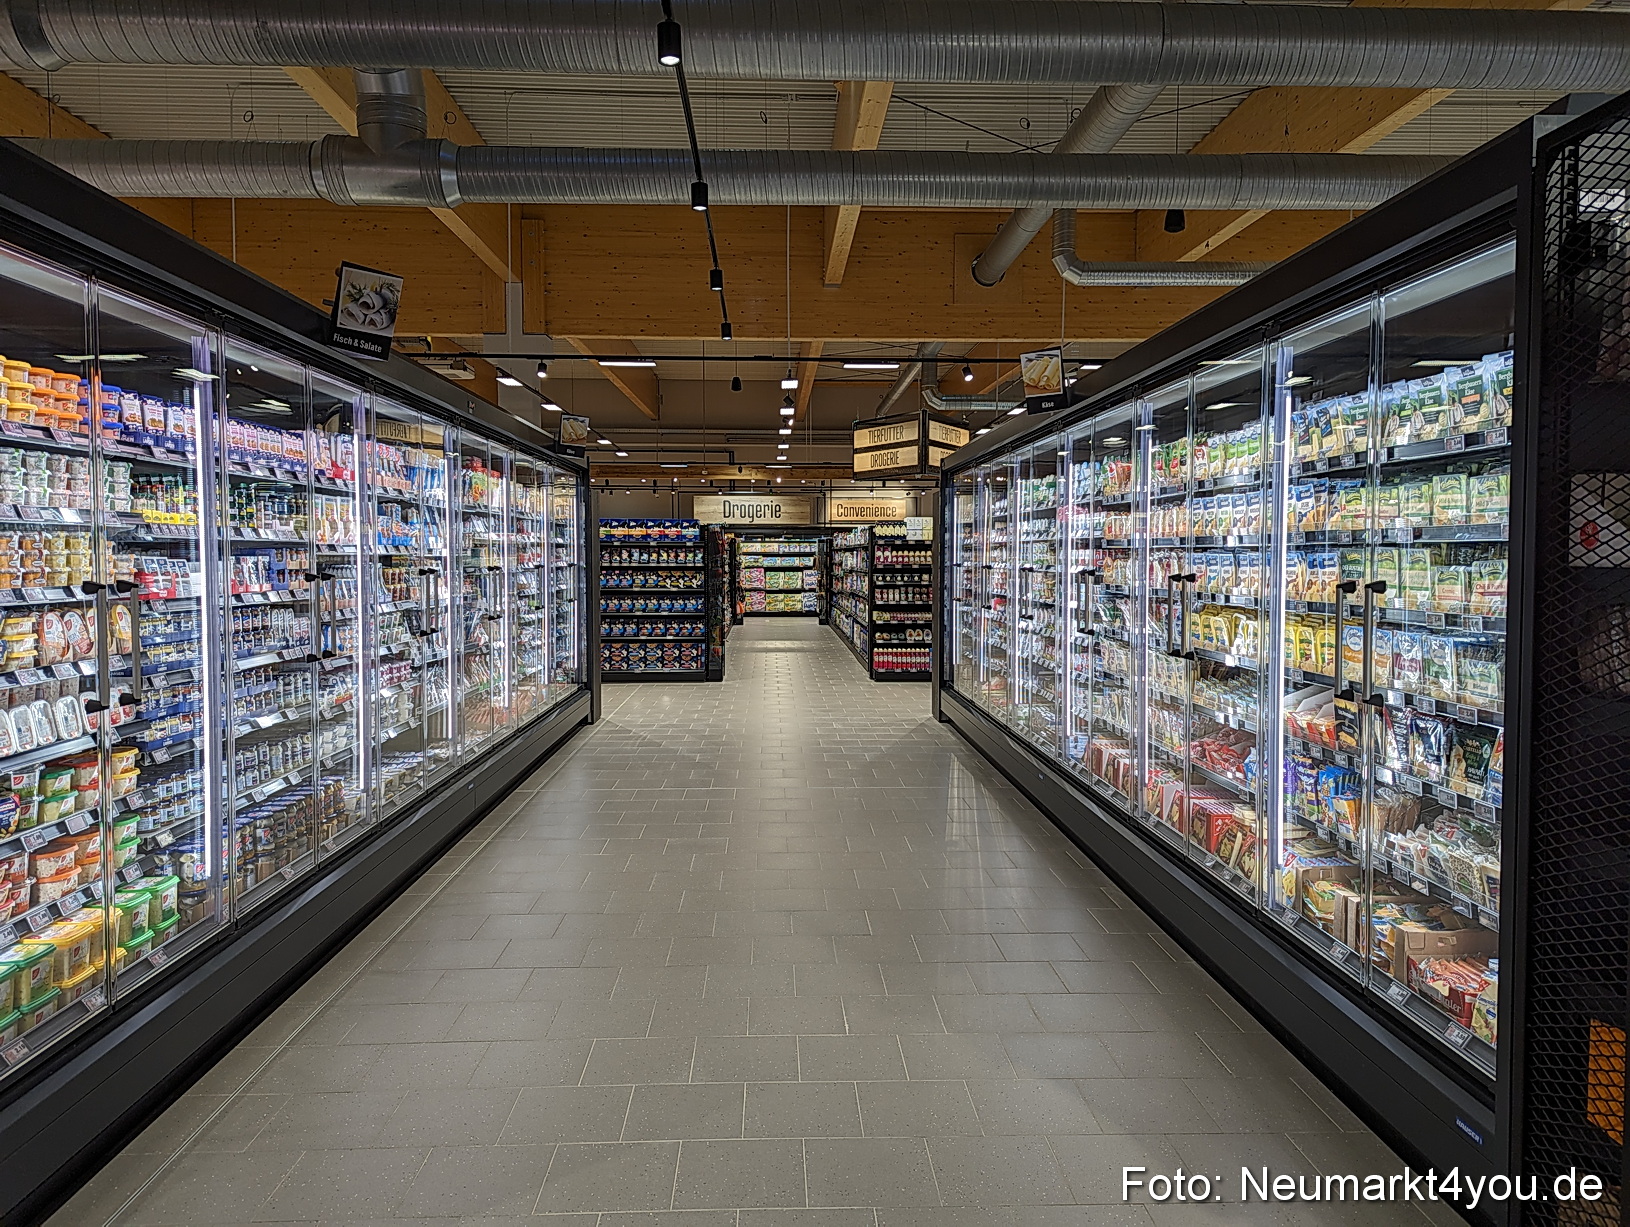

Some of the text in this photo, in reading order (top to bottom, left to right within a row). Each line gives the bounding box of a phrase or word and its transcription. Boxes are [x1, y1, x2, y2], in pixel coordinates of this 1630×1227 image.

[333, 332, 382, 353] Fisch & Salate
[868, 425, 905, 445] TIERFUTTER
[939, 425, 962, 445] TIERFUTTER
[870, 450, 900, 469] DROGERIE
[722, 499, 782, 523] Drogerie
[836, 502, 897, 518] Convenience
